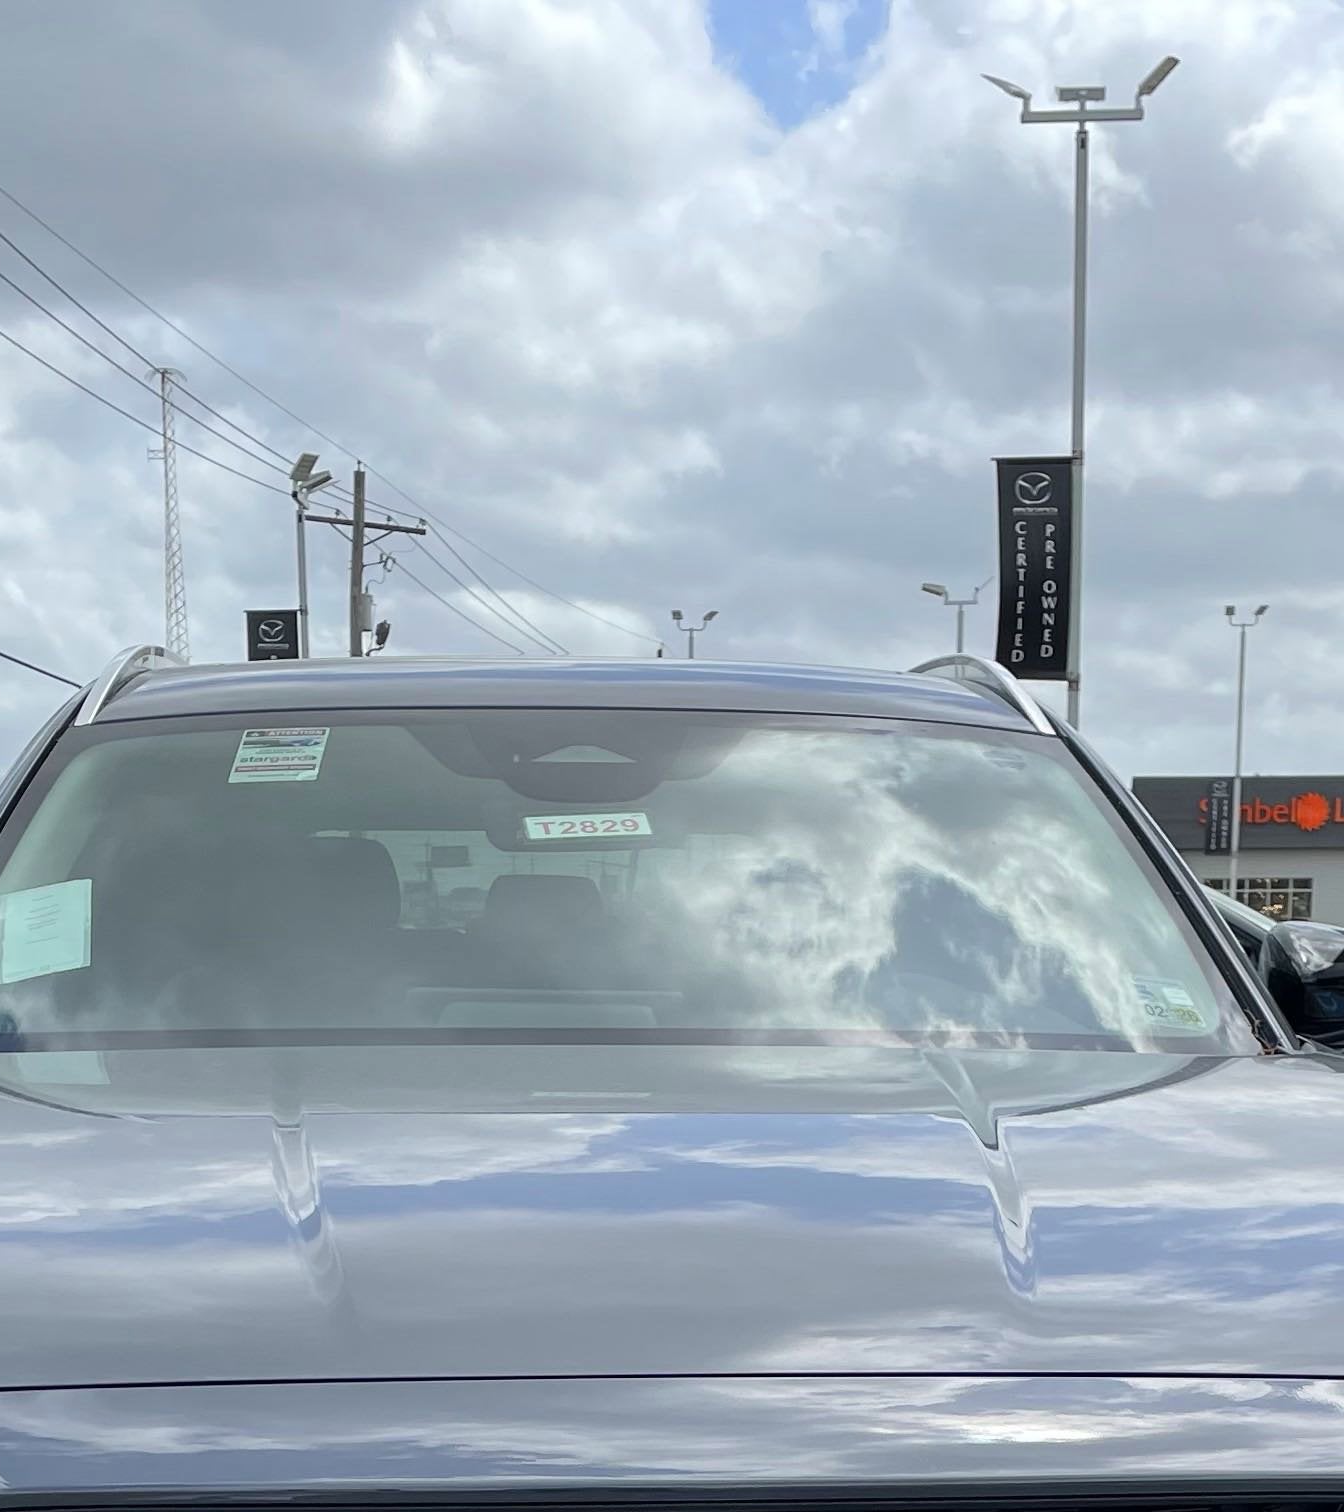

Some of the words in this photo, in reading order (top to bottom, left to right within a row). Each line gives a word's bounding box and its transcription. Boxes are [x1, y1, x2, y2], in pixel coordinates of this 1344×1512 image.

[1044, 523, 1057, 570] PRE
[1010, 521, 1028, 663] CERTIFIED
[1040, 579, 1058, 658] OWNED
[534, 818, 640, 836] T2829
